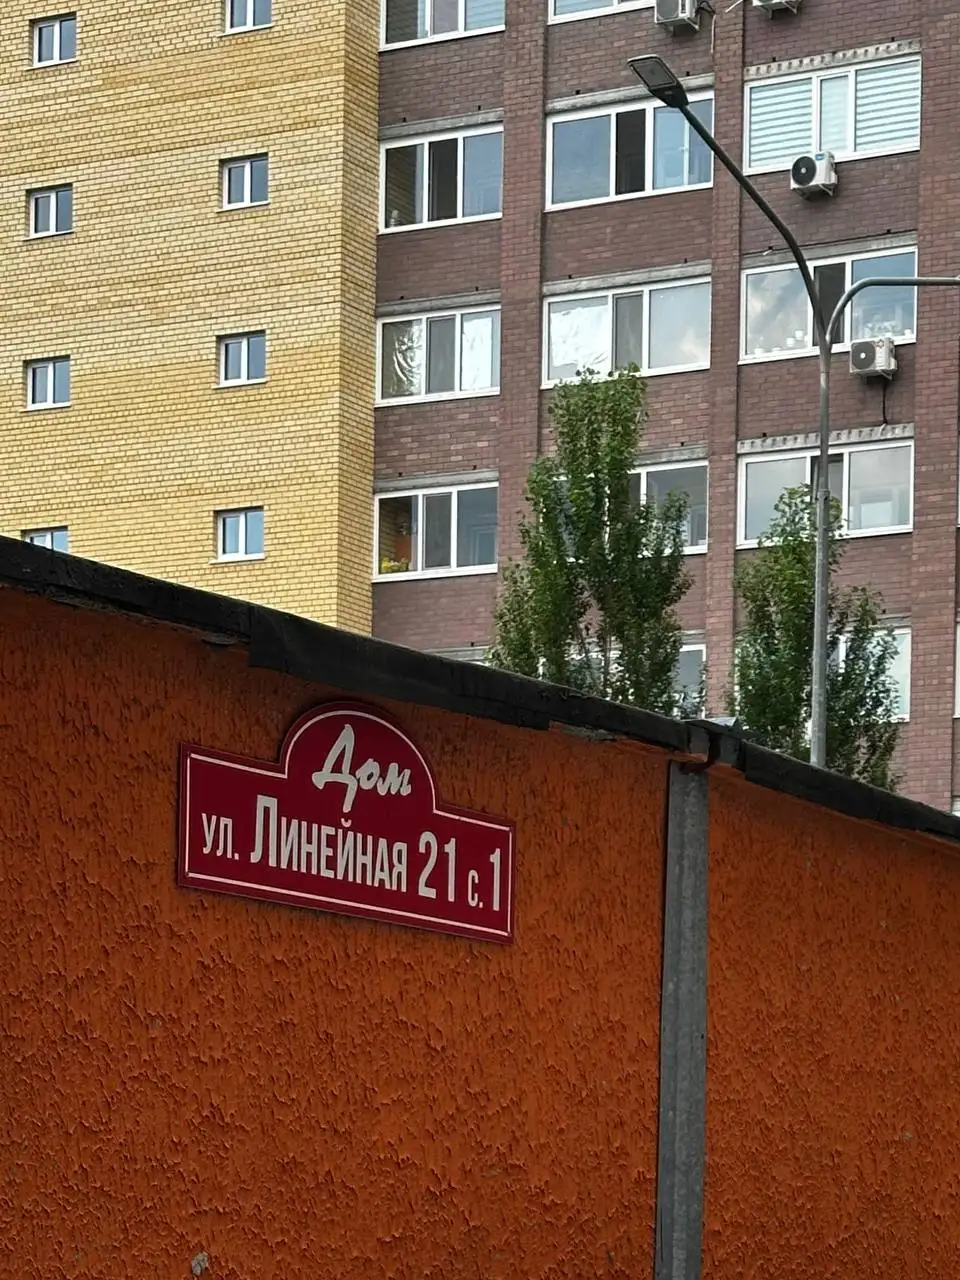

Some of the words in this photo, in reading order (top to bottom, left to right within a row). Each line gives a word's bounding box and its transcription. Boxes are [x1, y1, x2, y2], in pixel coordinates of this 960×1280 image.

[311, 724, 412, 813] Дом
[201, 812, 240, 861] ул.
[418, 831, 457, 903] 21
